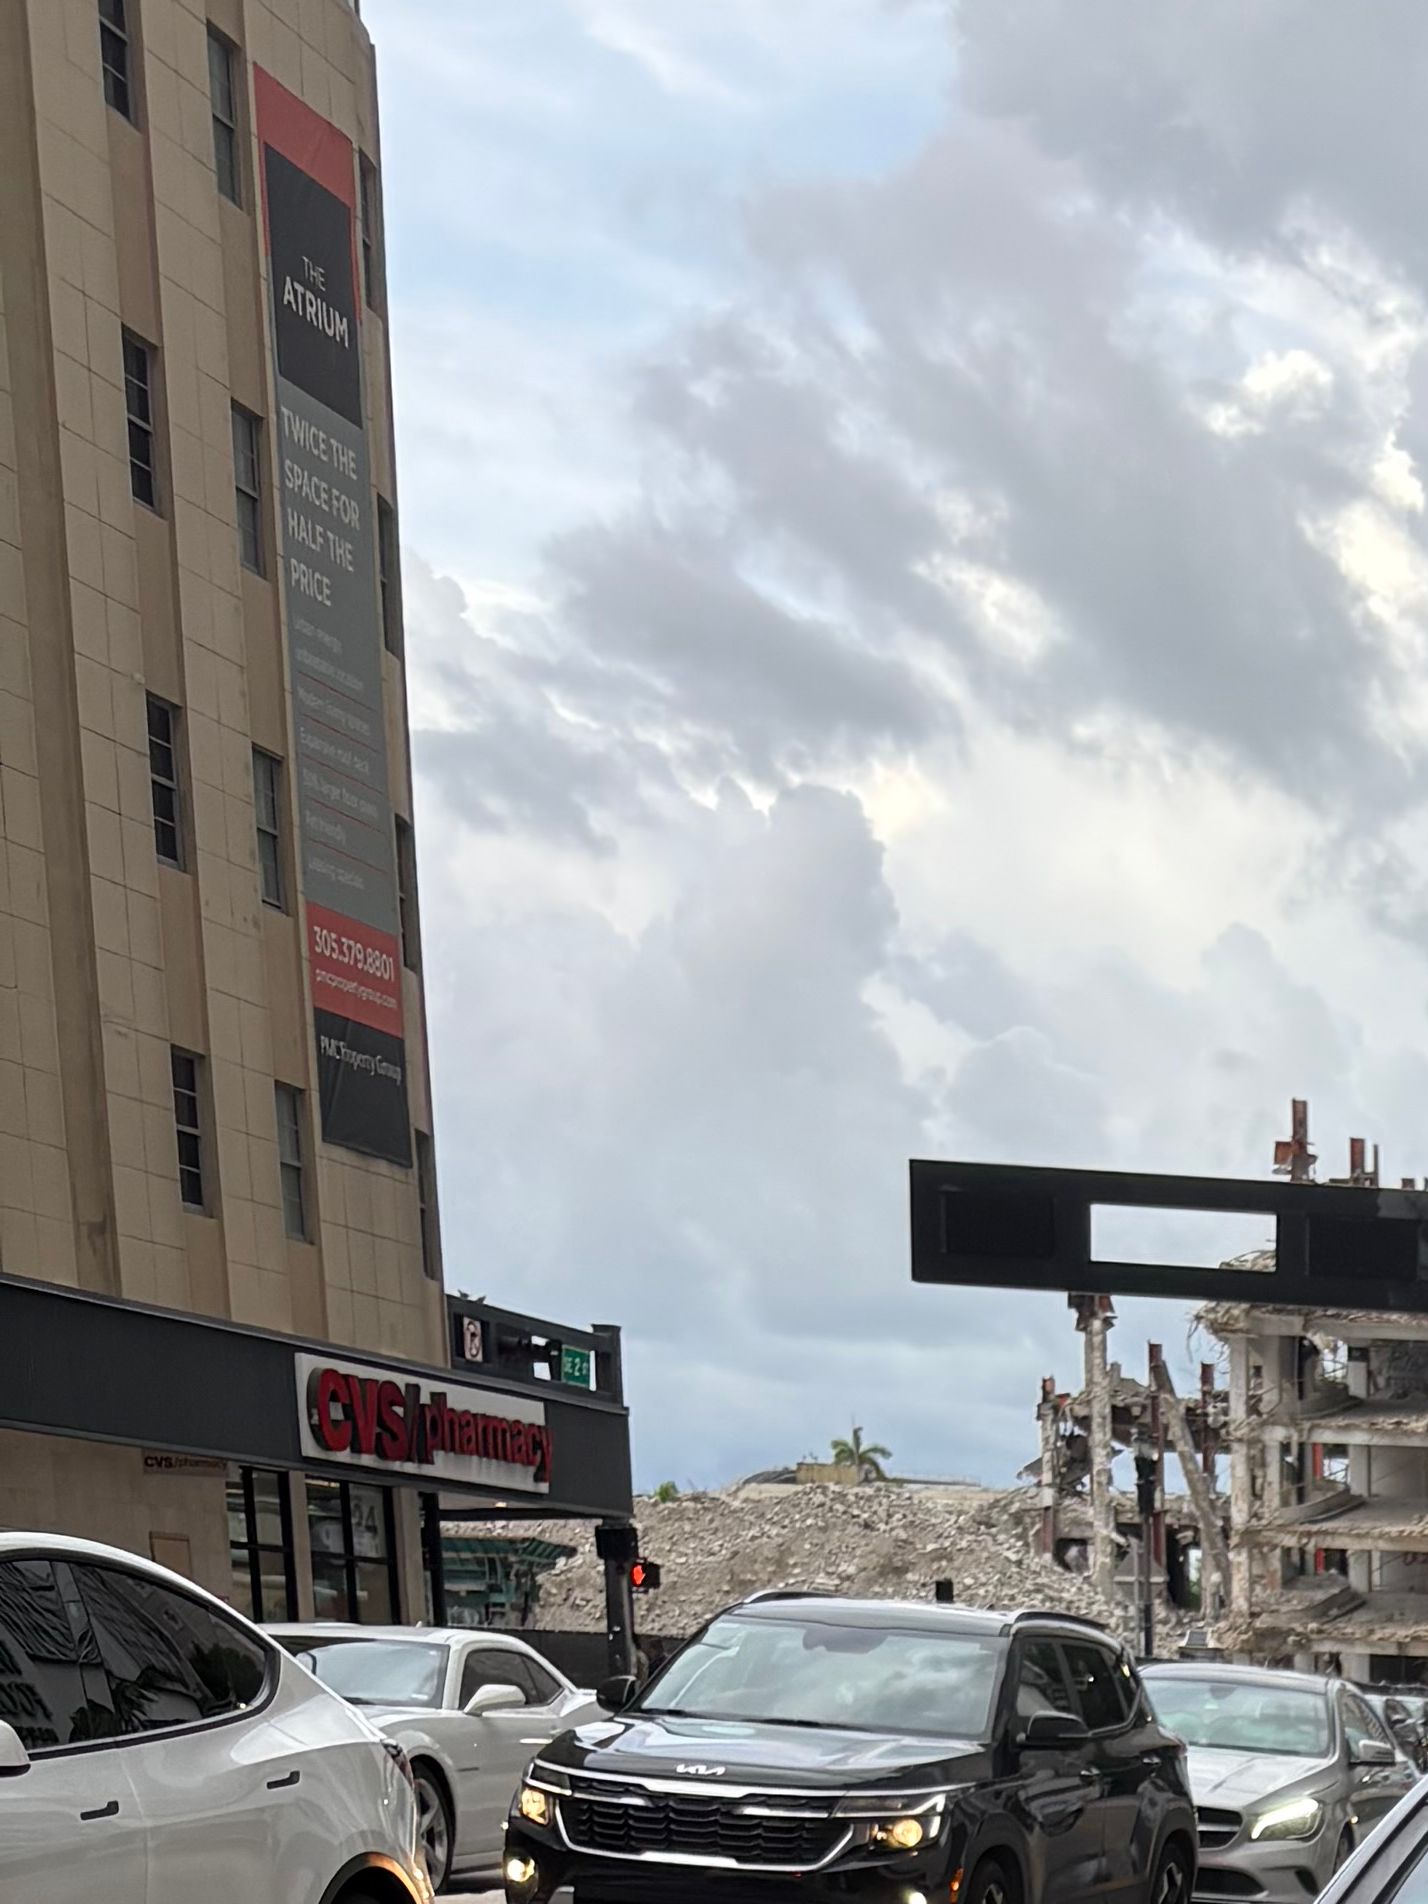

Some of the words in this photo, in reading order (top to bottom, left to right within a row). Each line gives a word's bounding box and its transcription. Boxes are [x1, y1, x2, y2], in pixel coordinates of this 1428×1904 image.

[302, 255, 326, 292] THE
[283, 275, 349, 349] ATRIUM
[281, 405, 329, 463] TWICE
[330, 438, 358, 481] THE
[284, 458, 330, 512] SPACE
[331, 488, 361, 531] FOR
[287, 507, 325, 552] HALF
[326, 531, 355, 572] THE
[290, 557, 332, 607] PRICE
[313, 925, 395, 983] 305.379.8801
[573, 1357, 581, 1377] 2
